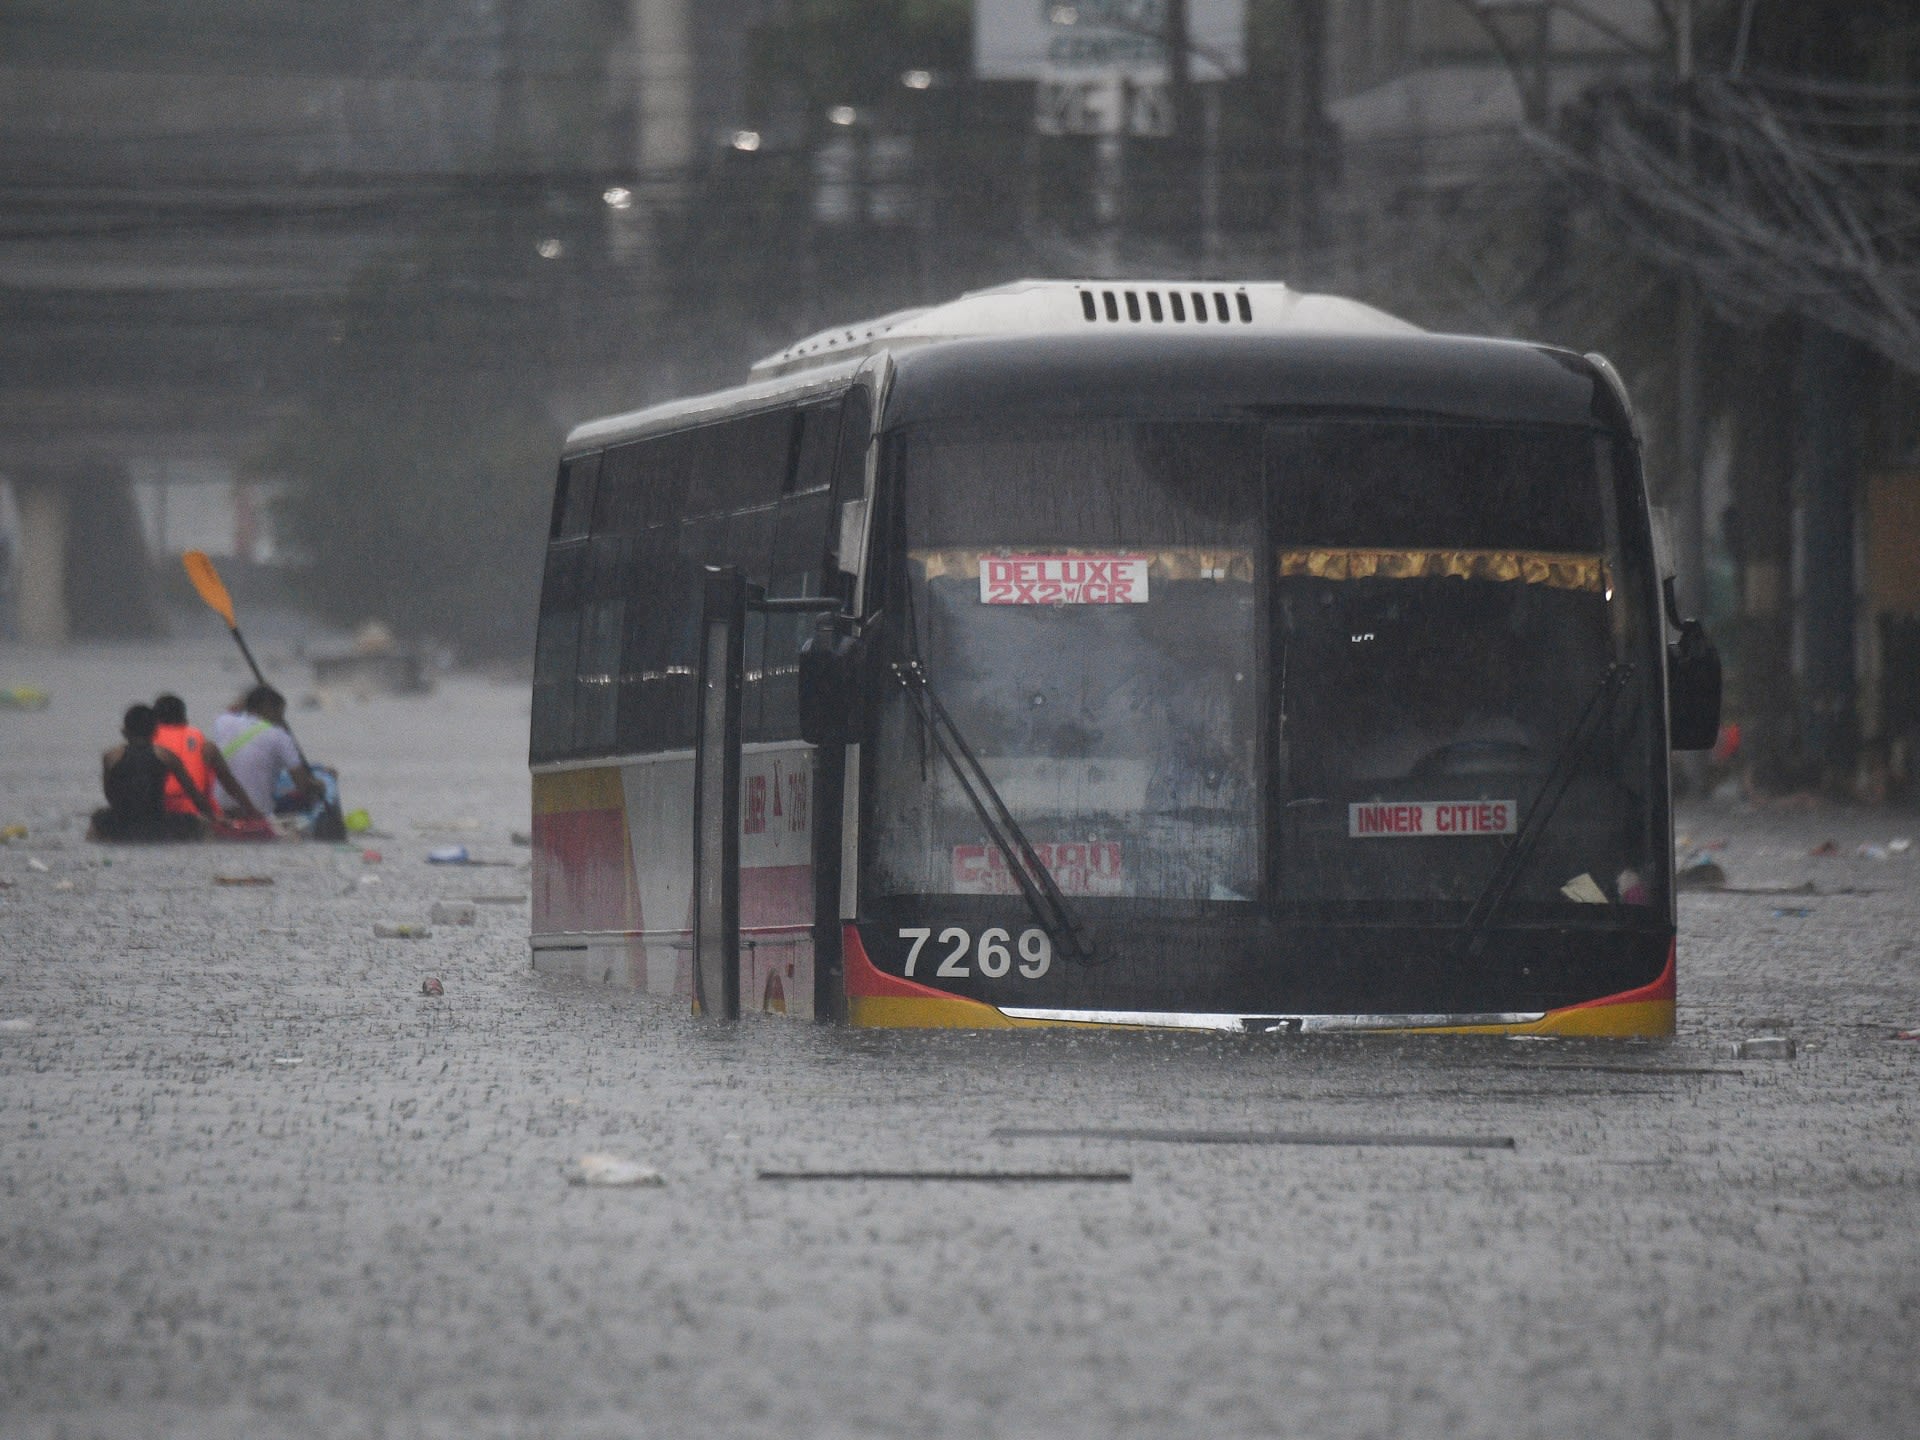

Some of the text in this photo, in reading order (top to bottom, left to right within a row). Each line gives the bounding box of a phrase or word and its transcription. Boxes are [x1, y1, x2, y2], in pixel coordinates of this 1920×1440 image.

[988, 562, 1134, 584] DELUXE
[1358, 804, 1508, 833] INNER CITIES
[898, 927, 1052, 979] 7269
